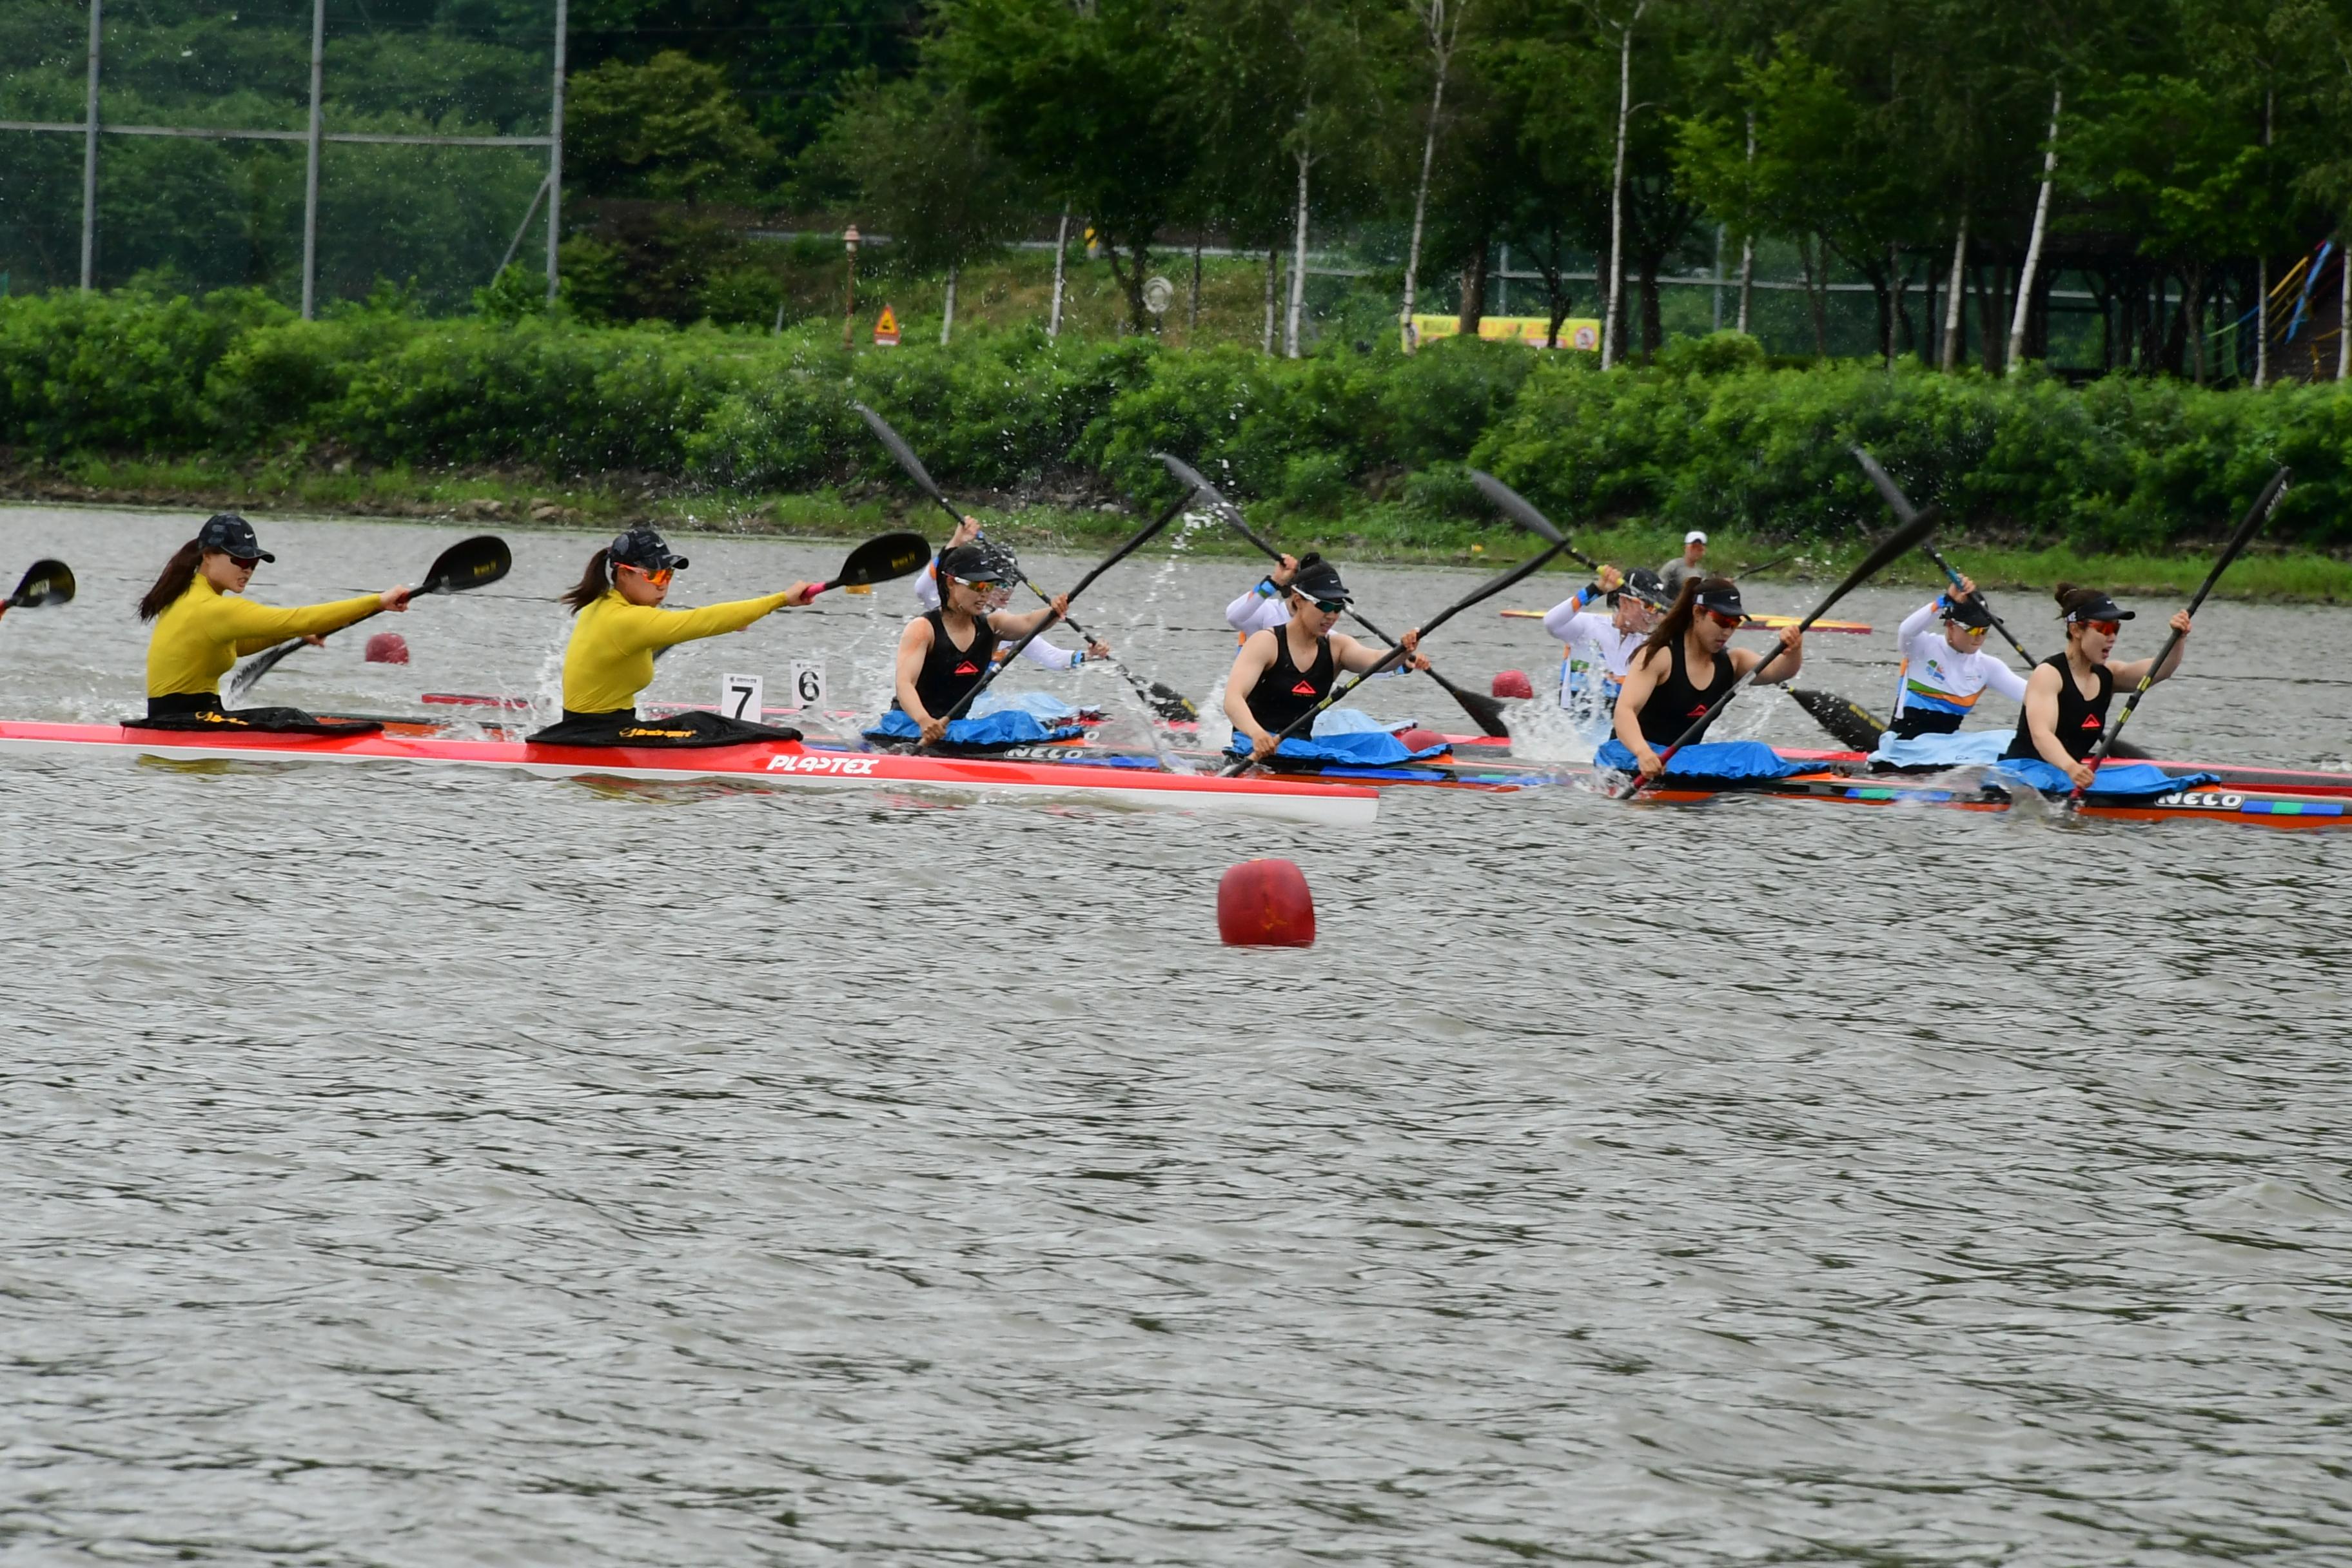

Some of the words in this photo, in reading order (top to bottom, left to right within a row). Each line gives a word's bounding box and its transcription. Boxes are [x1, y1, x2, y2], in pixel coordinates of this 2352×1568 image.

[798, 671, 820, 702] 6
[731, 685, 754, 720] 7
[1007, 747, 1084, 760] NELO
[766, 754, 880, 774] PLASTEX
[2157, 792, 2242, 807] NELO
